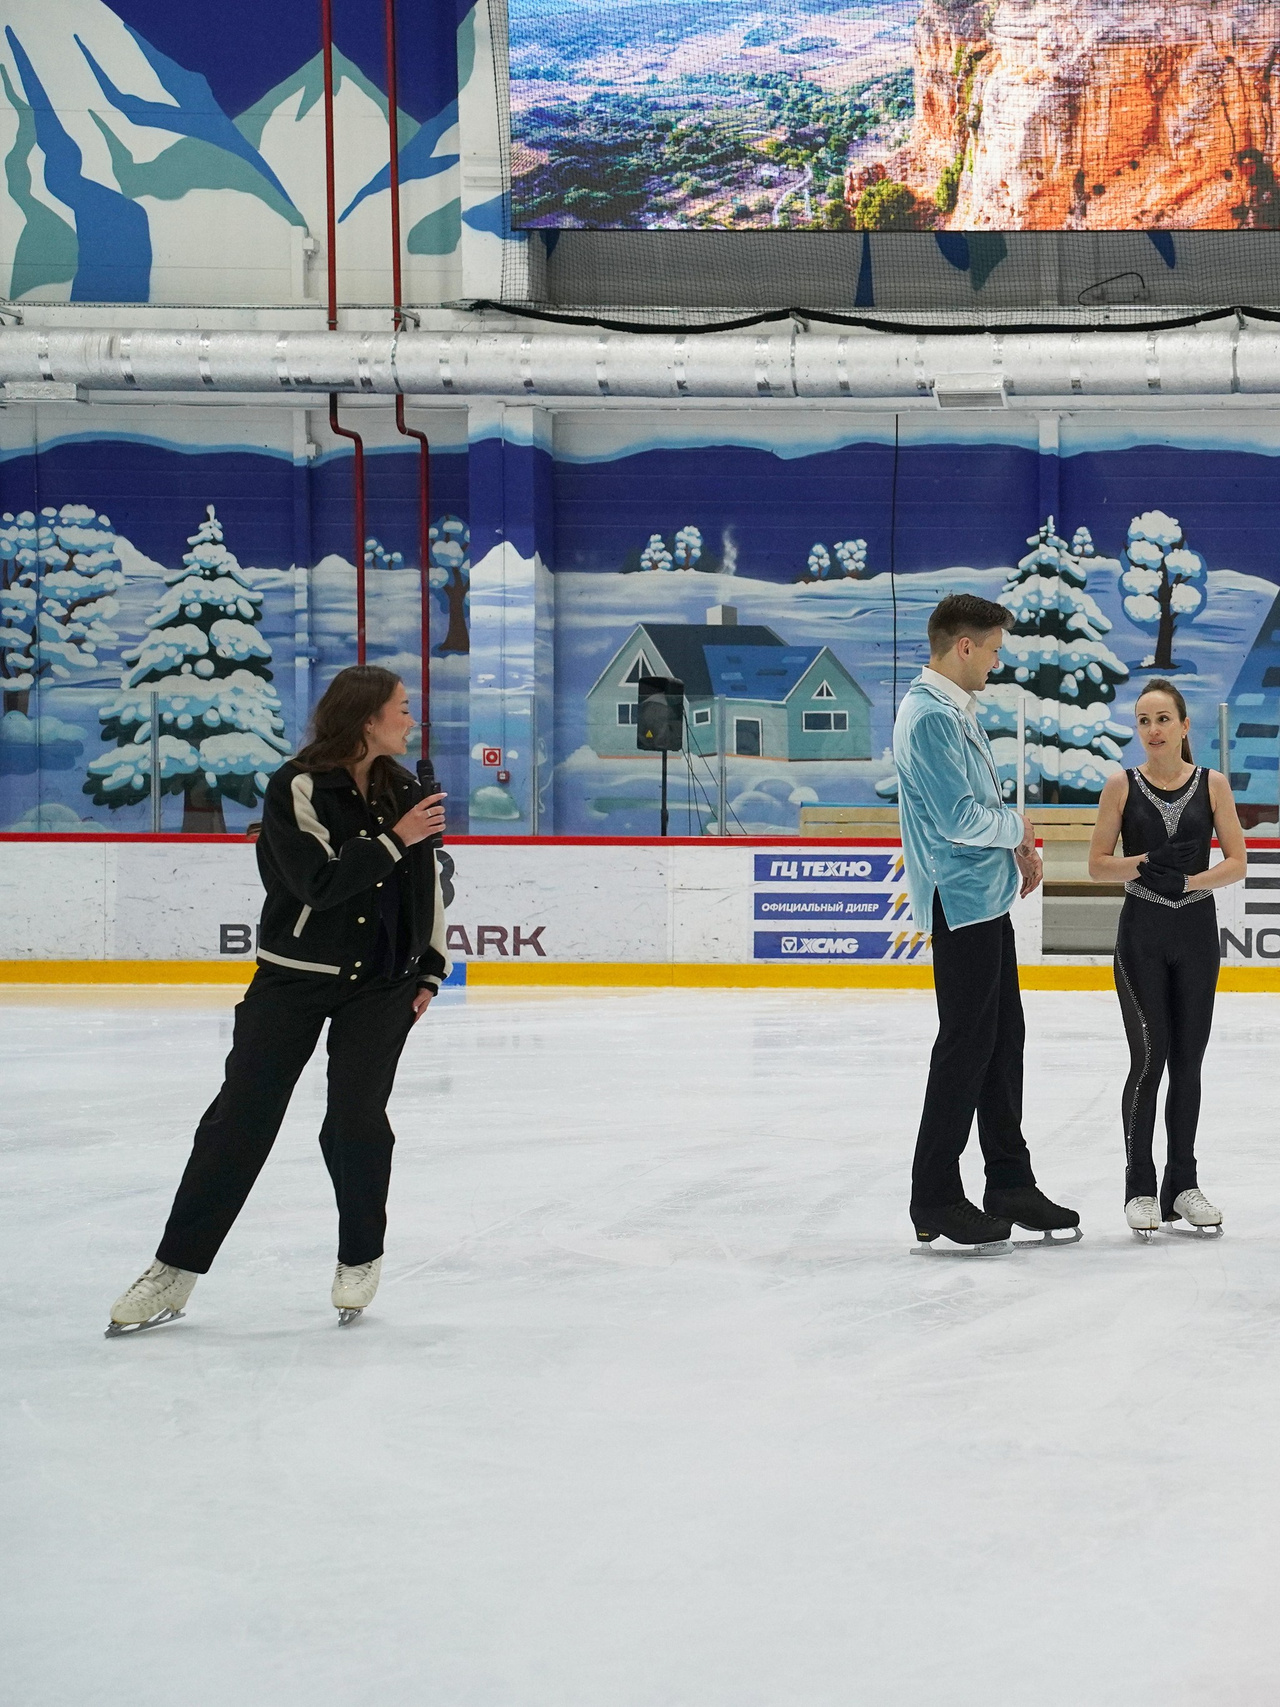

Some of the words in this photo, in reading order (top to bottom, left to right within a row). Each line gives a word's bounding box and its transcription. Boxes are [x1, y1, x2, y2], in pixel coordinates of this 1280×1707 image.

[770, 861, 798, 879] ГЦ
[801, 861, 872, 877] ТЕХНО
[761, 901, 843, 914] ОФИЦИАЛЬНЫЙ
[845, 902, 879, 914] ДИЛЕР
[797, 937, 859, 954] XCMG
